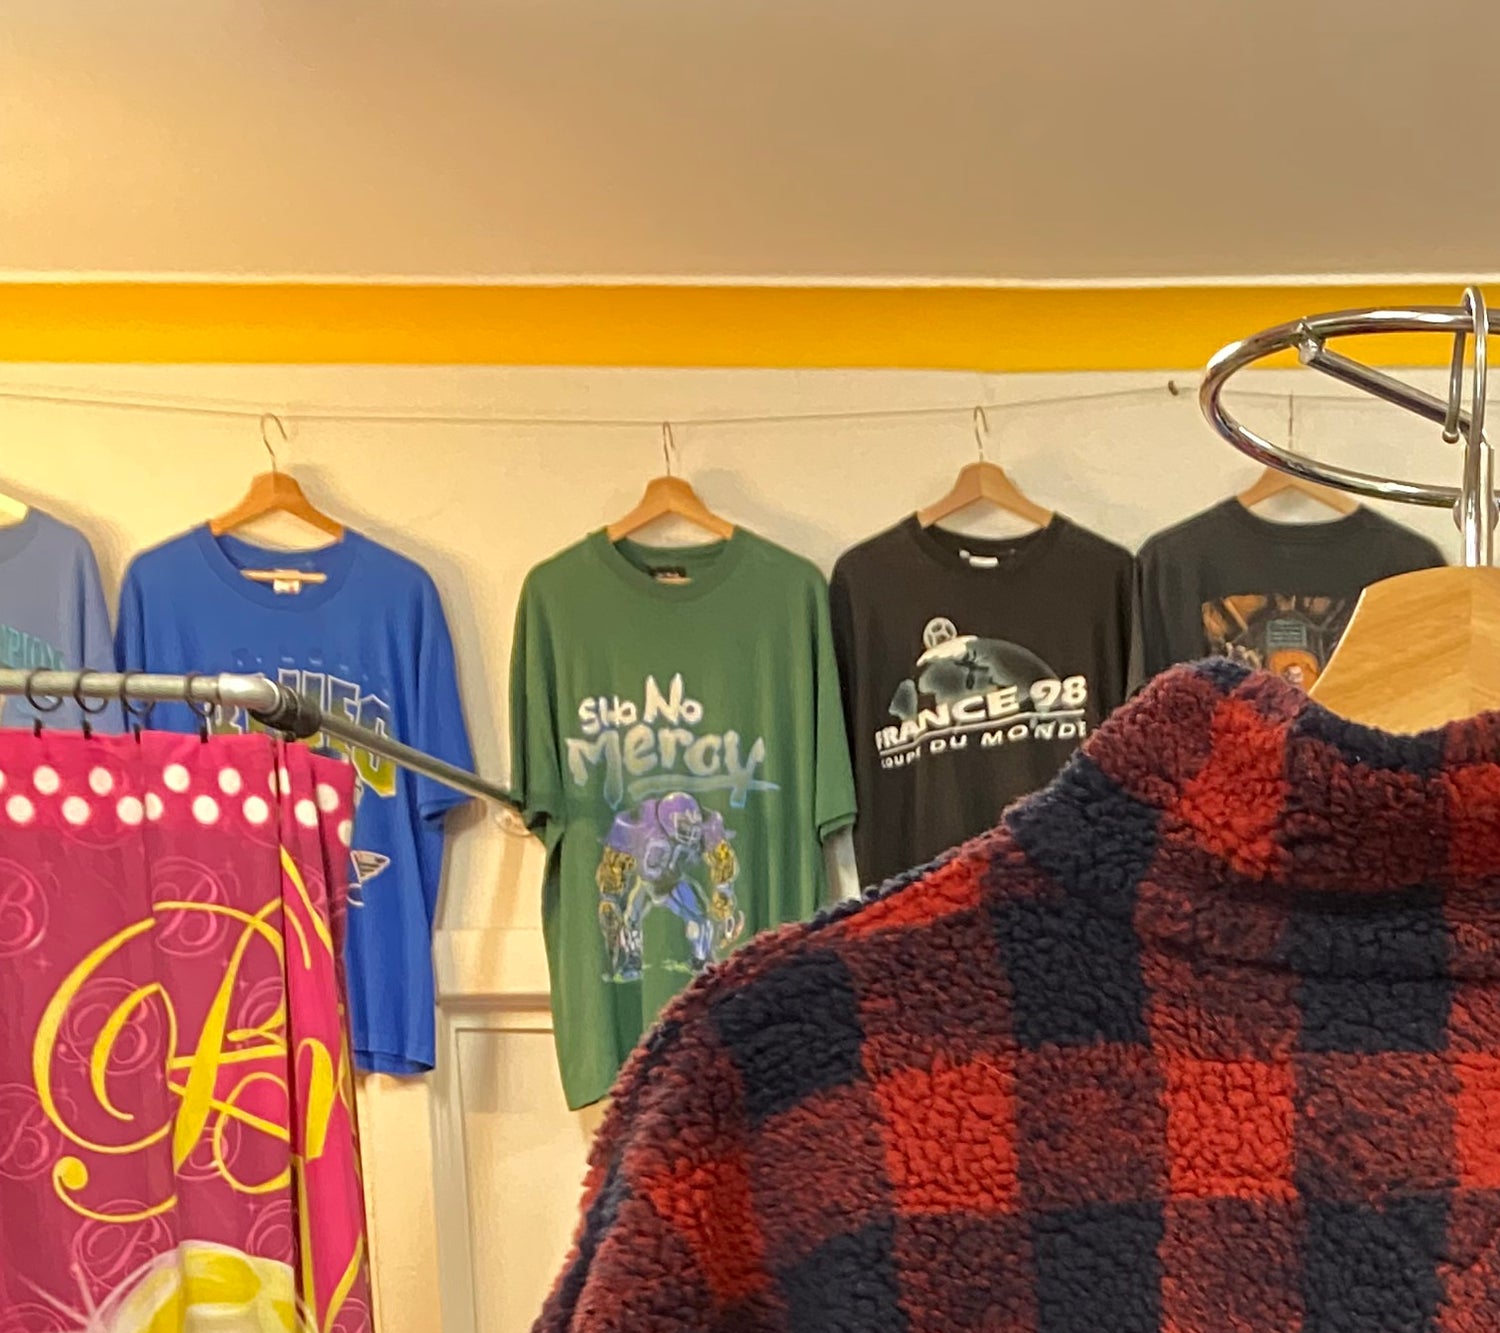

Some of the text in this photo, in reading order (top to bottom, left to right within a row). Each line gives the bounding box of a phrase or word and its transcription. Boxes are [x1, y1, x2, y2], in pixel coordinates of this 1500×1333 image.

[643, 672, 703, 725] No
[874, 675, 1087, 751] FRANCE 98
[565, 723, 770, 810] Mercy
[929, 733, 968, 754] DU
